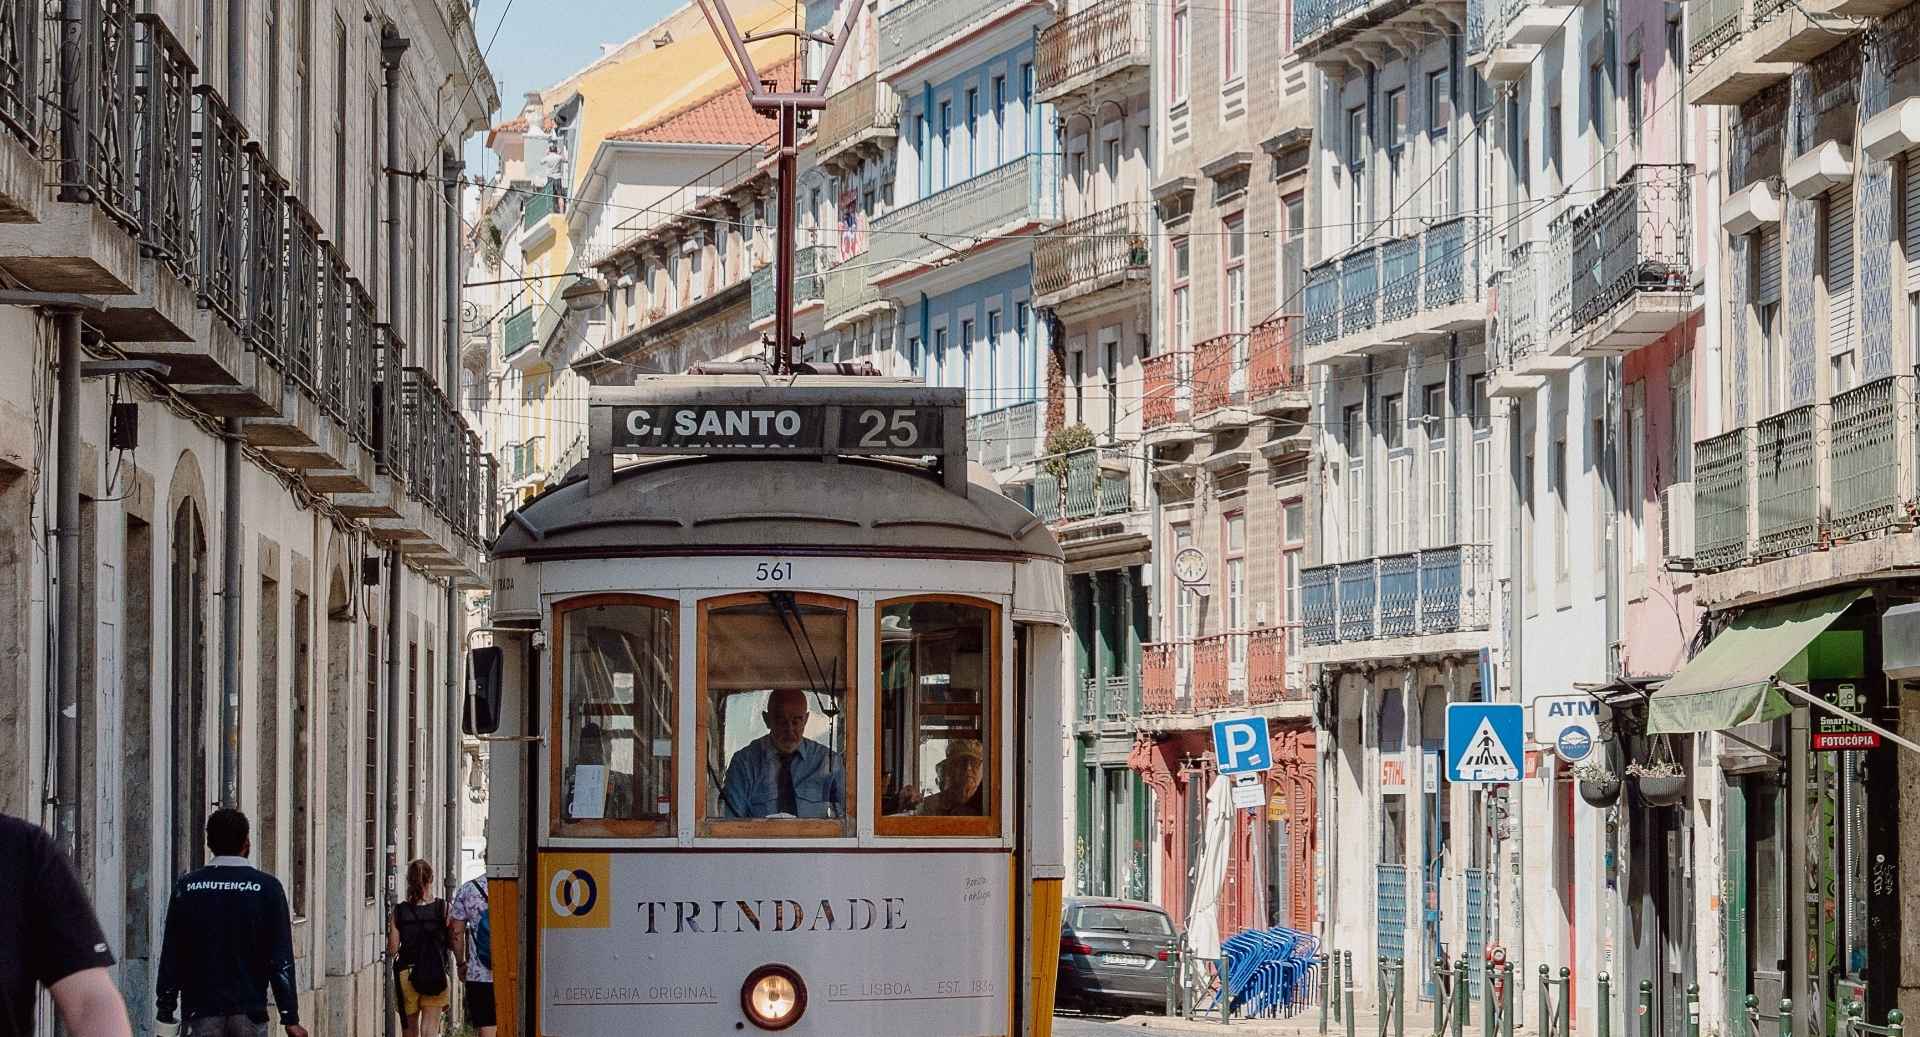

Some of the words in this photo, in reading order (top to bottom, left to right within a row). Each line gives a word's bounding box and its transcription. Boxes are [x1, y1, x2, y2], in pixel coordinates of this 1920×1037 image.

[626, 410, 662, 436] C.
[674, 410, 801, 436] SANTO
[859, 409, 918, 448] 25
[756, 562, 792, 581] 561
[1549, 701, 1600, 717] ATM
[1225, 723, 1257, 769] P
[1821, 735, 1874, 746] FOTOCÓPIA
[186, 881, 261, 892] MANUTENÇÃO
[637, 896, 908, 934] TRINDADE
[565, 987, 641, 1000] CERVEJARIA
[649, 985, 717, 999] ORIGINAL
[828, 983, 849, 997] DE
[862, 981, 912, 996] LISBOA
